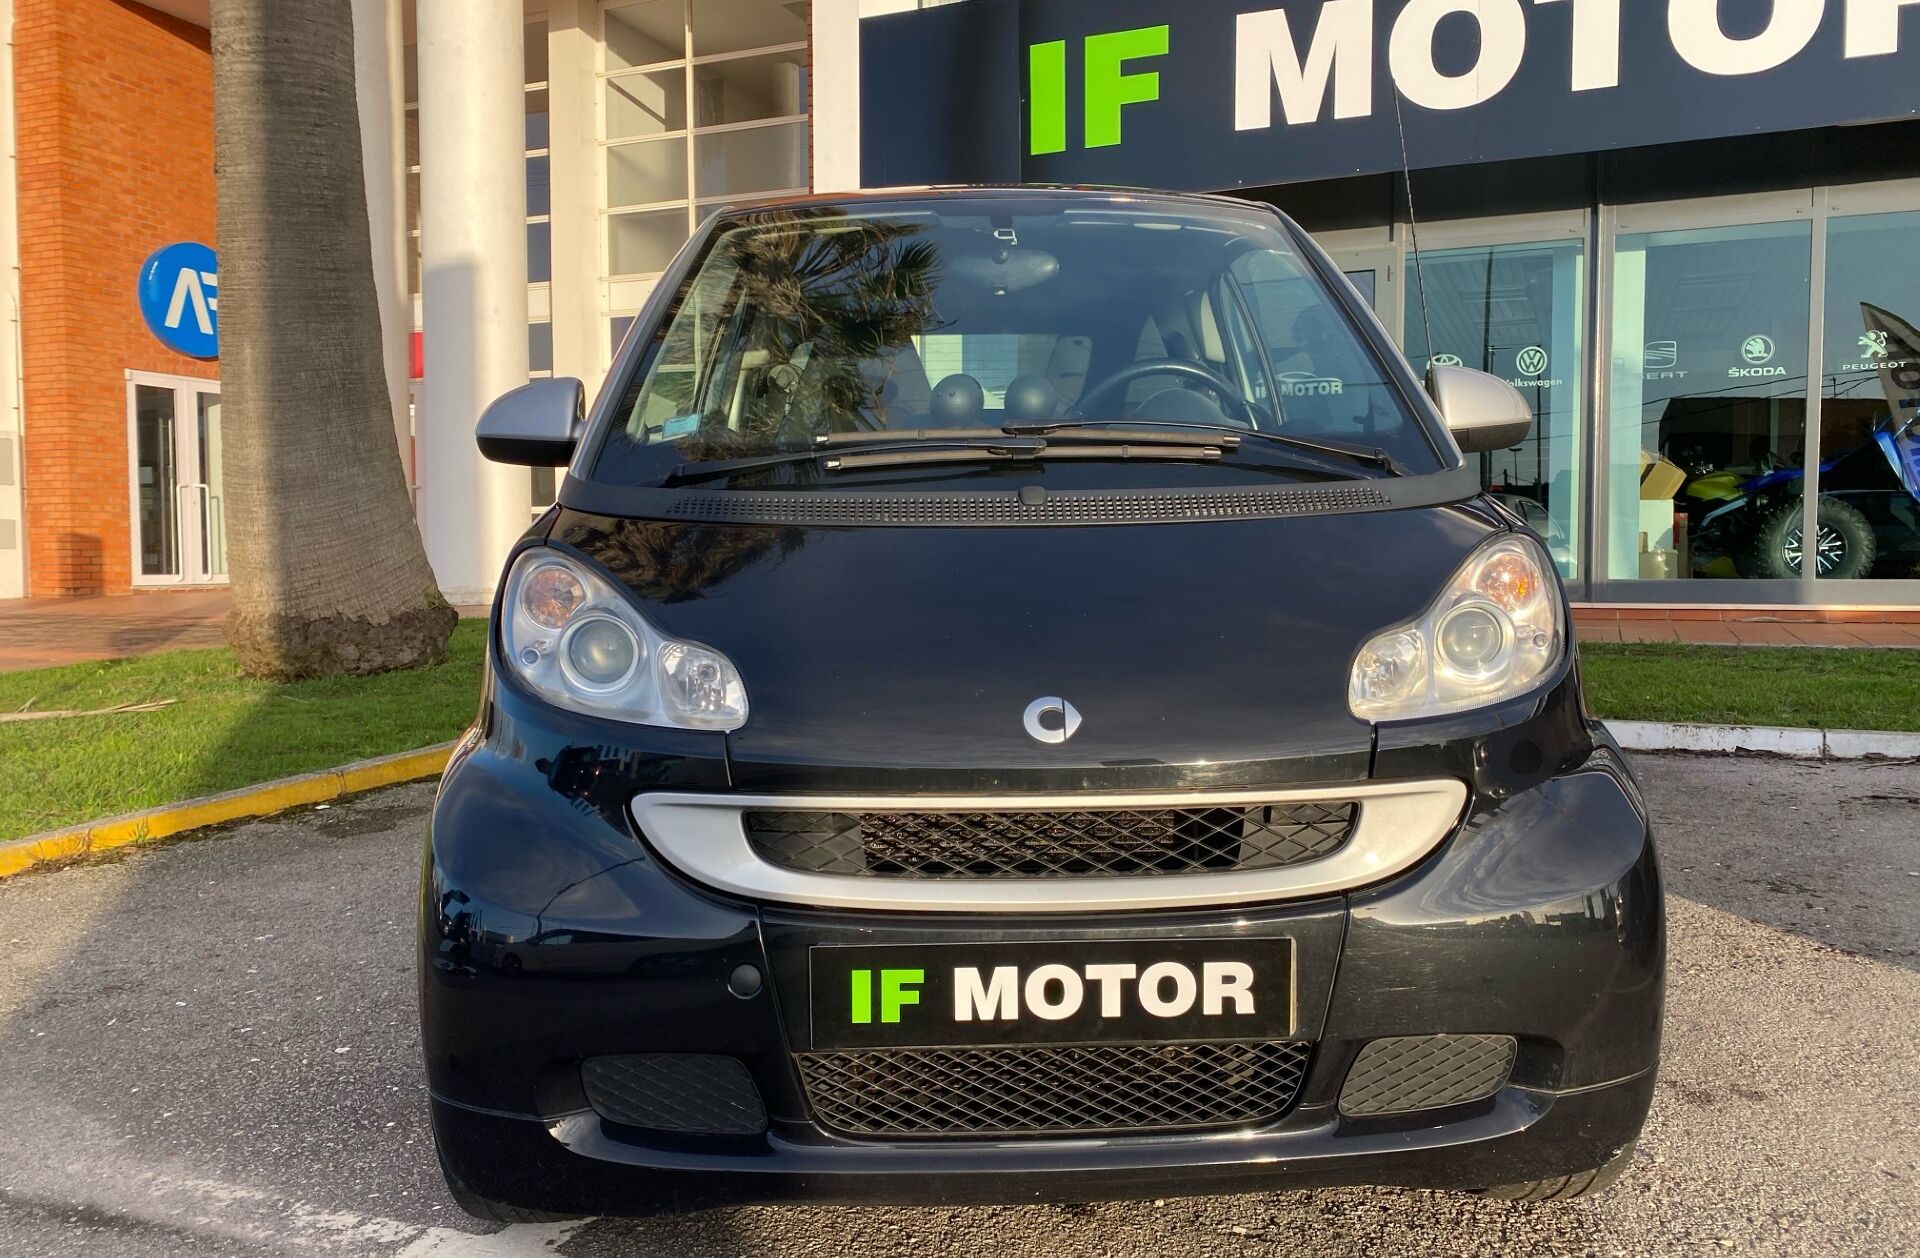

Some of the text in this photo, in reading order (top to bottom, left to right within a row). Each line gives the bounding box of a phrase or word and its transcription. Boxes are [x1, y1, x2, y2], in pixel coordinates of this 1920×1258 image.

[1030, 24, 1169, 155] IF
[1728, 366, 1787, 378] ŠKODA
[1842, 361, 1907, 371] PEUGEOT
[1281, 381, 1343, 396] MOTOR
[1505, 378, 1563, 388] olkswagen
[851, 961, 1256, 1023] IF MOTOR
